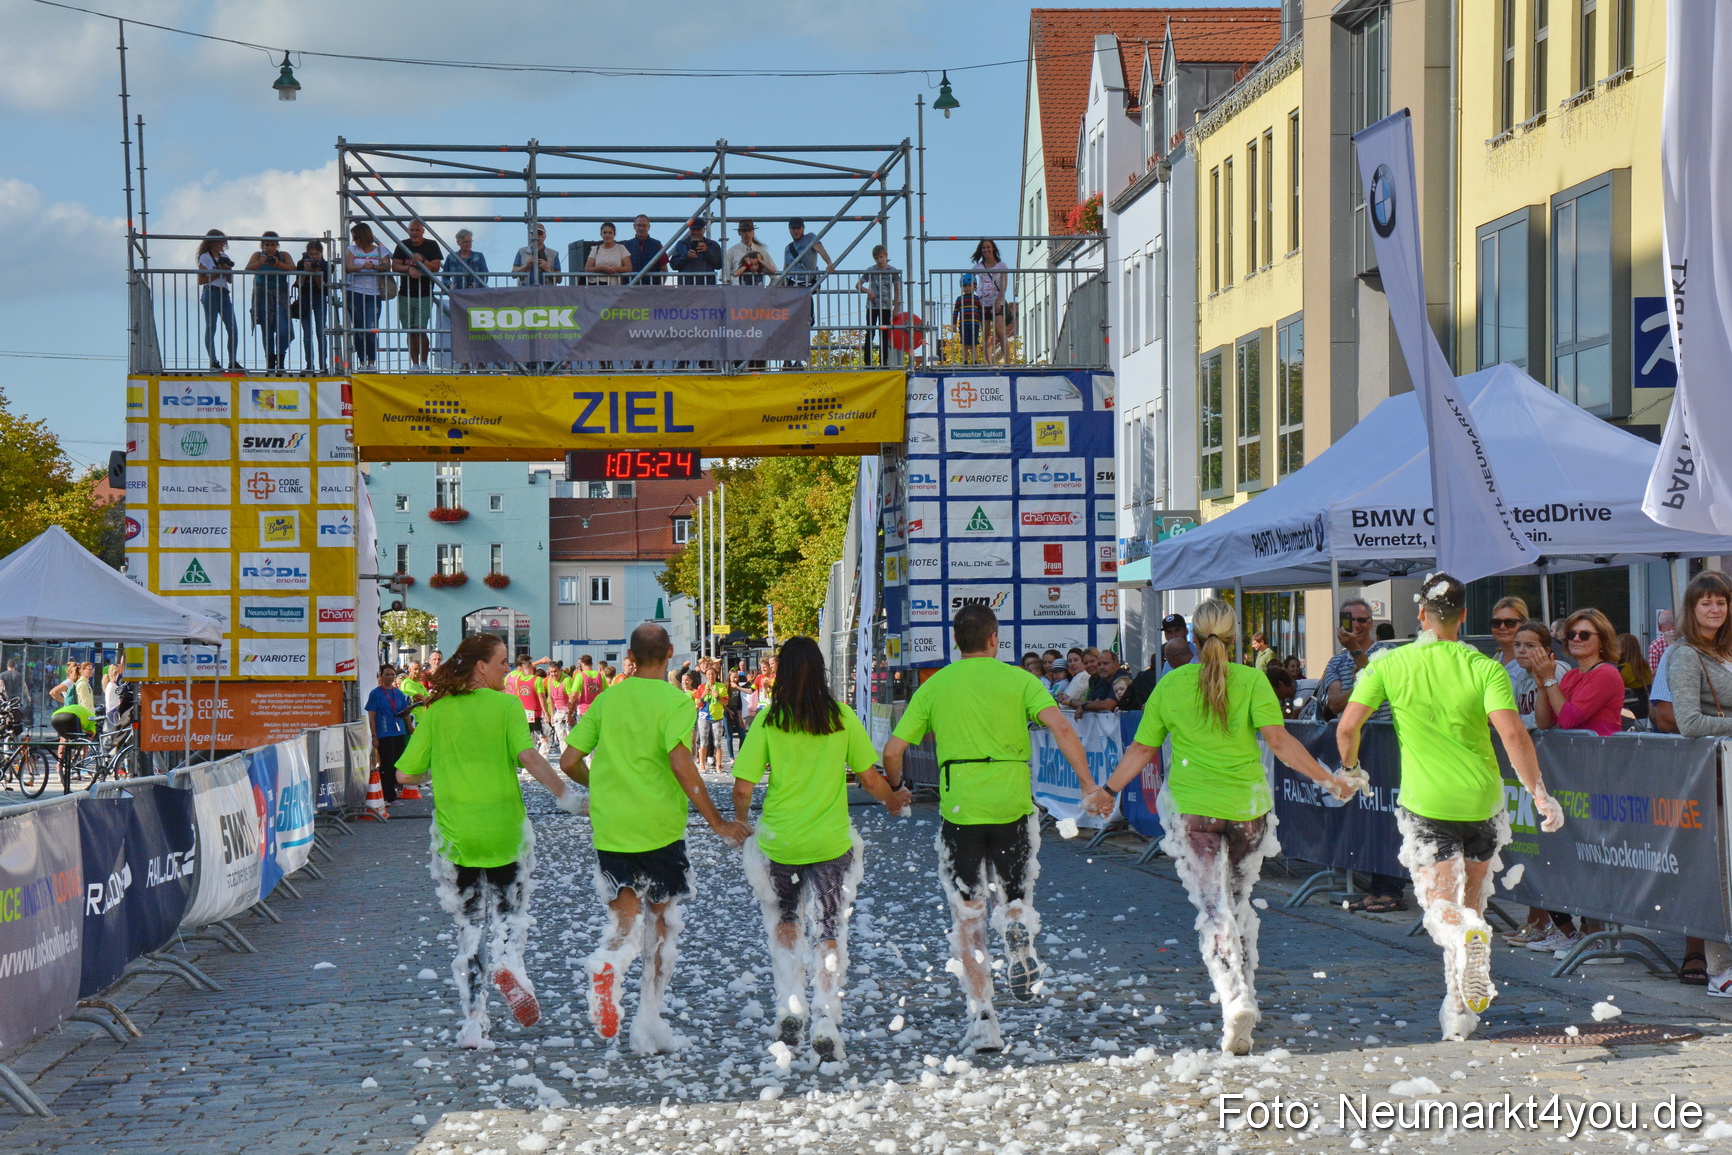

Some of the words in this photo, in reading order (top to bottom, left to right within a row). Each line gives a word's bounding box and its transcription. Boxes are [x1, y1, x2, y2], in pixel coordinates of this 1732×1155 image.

[468, 307, 577, 330] BOCK
[600, 308, 649, 320] OFFICE
[654, 308, 727, 320] INDUSTRY
[731, 308, 791, 320] LOUNGE
[469, 332, 502, 342] inspired
[505, 332, 515, 341] by
[544, 332, 582, 341] concepts
[628, 326, 763, 338] www.bockonline.de
[382, 412, 448, 424] Neumarkter
[451, 416, 502, 425] Stadtlauf
[571, 391, 694, 434] ZIEL
[761, 412, 825, 423] Neumarkter
[828, 409, 878, 420] Stadtlauf
[242, 436, 286, 448] swn
[1444, 394, 1496, 492] NEUMARKT
[606, 452, 692, 478] 1:05:24
[1352, 509, 1415, 528] BMW
[1251, 530, 1278, 558] PARTL
[1354, 534, 1427, 548] Vernetzt,
[1044, 561, 1062, 569] Braun
[1575, 838, 1679, 874] www.bockonline.de
